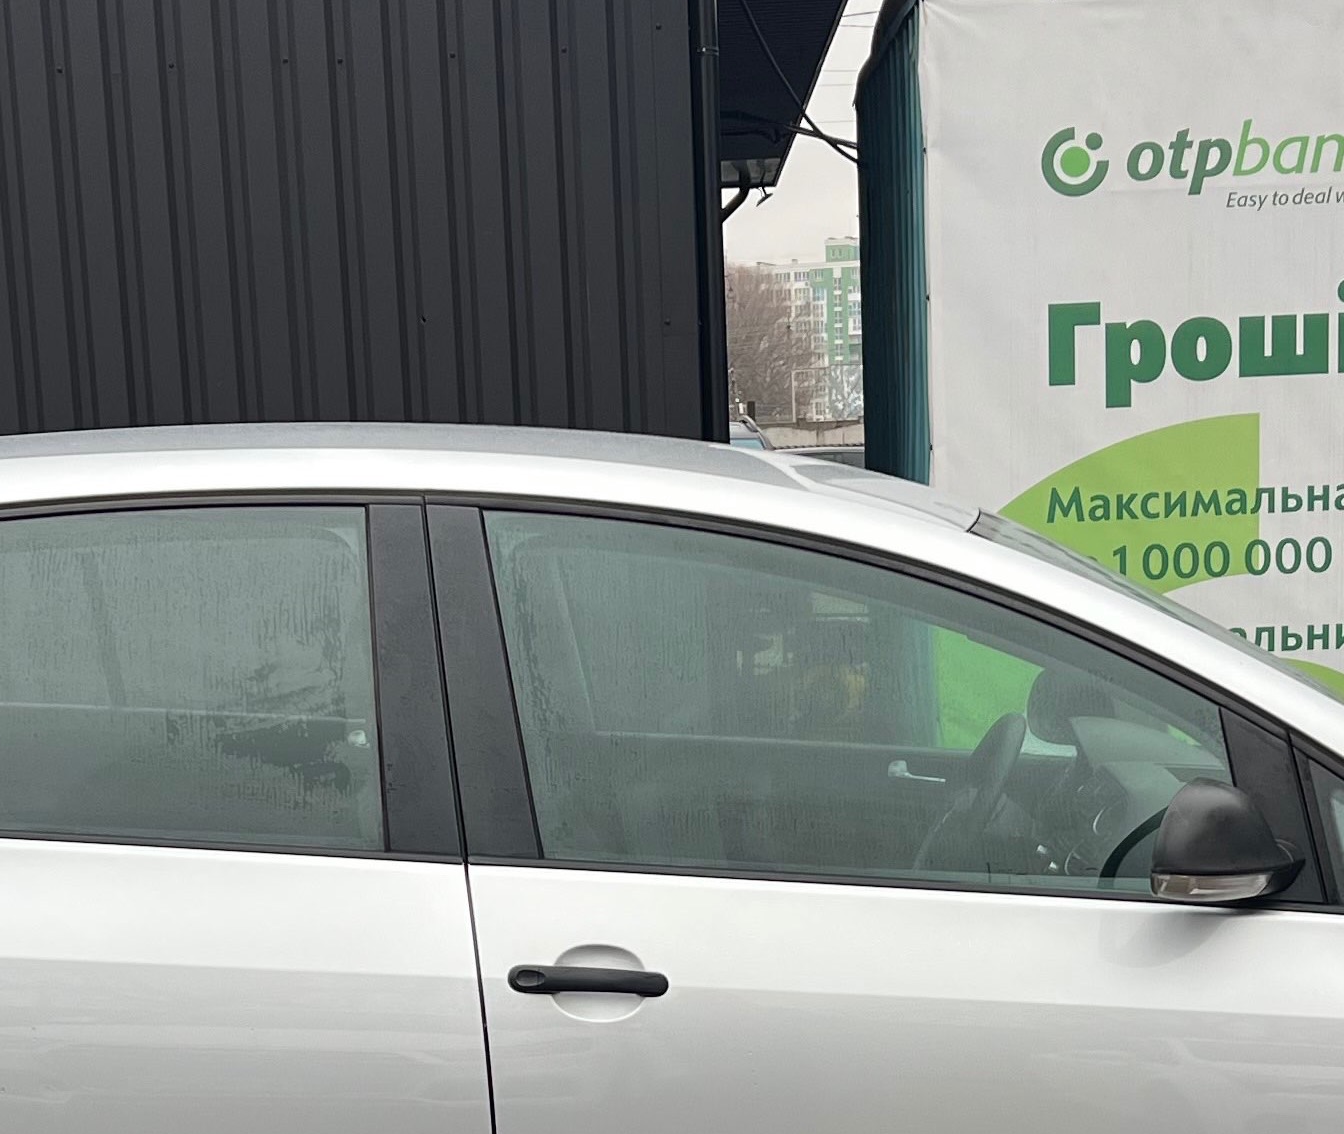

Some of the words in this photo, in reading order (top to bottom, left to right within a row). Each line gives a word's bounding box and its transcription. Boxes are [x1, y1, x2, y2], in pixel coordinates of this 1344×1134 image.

[1226, 191, 1268, 212] Easy
[1272, 191, 1289, 206] to
[1292, 187, 1333, 206] deal
